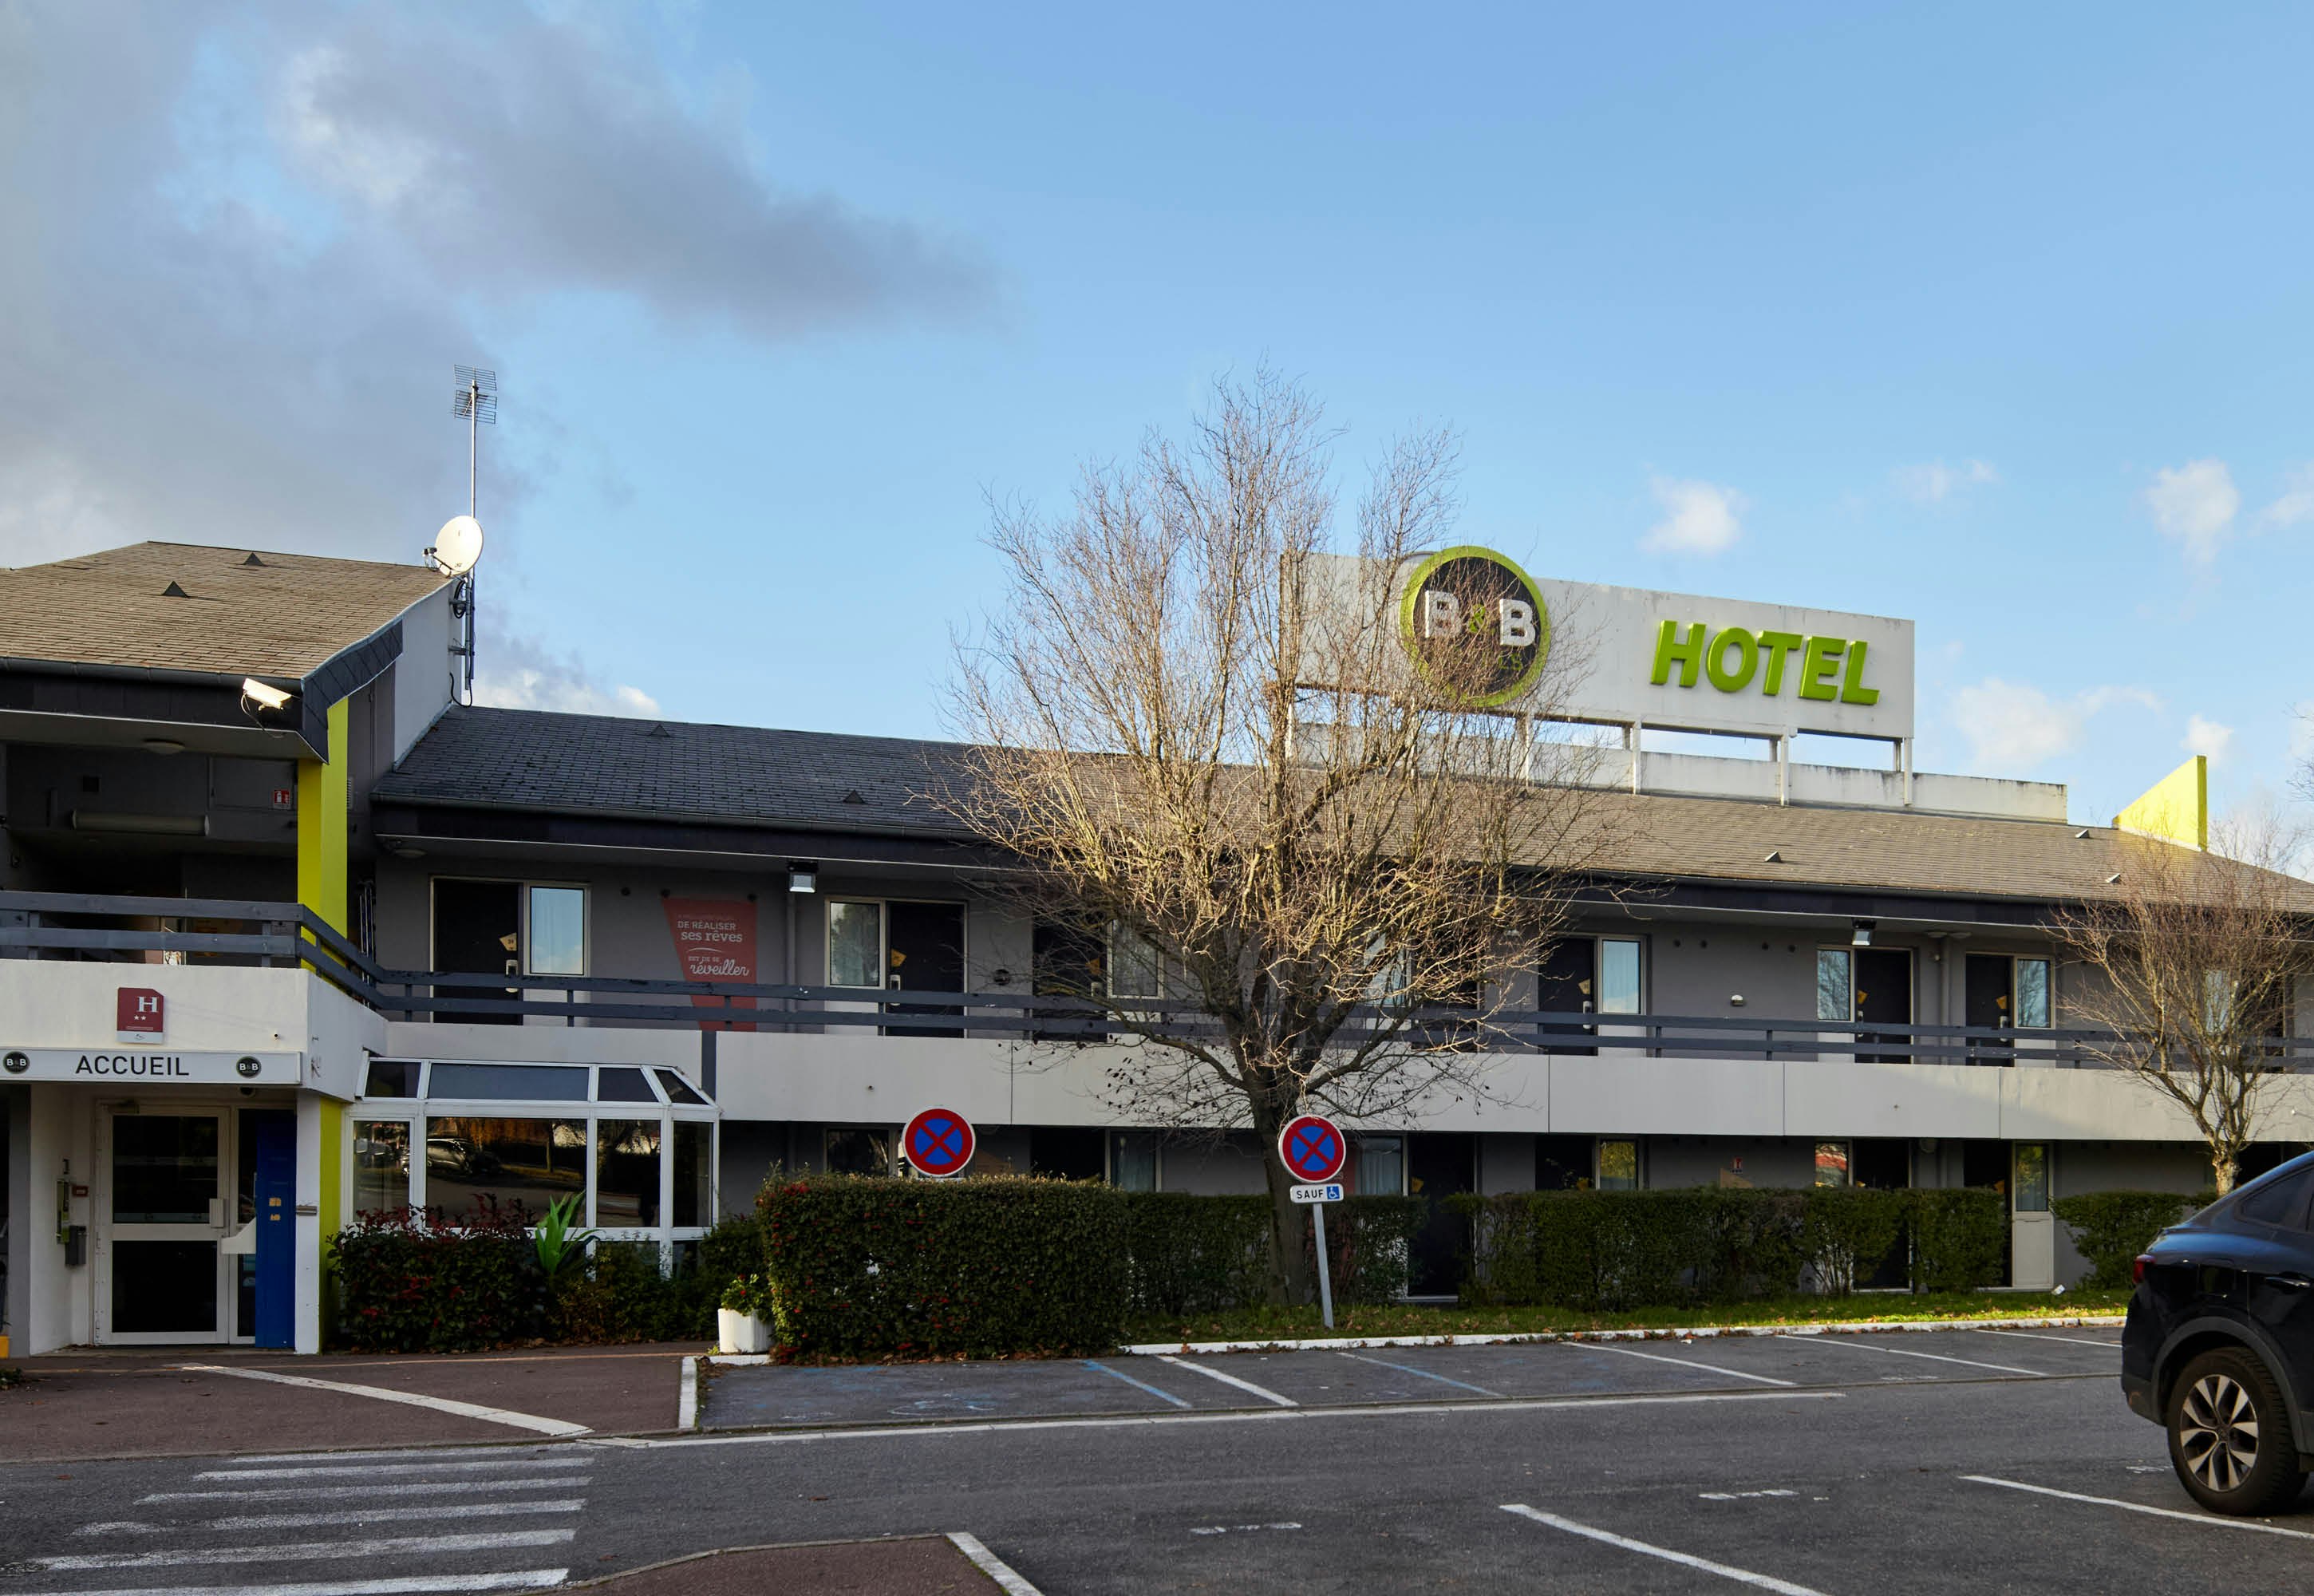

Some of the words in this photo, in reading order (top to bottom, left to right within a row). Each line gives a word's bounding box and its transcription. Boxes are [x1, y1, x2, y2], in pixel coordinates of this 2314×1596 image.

[1650, 619, 1880, 705] HOTEL
[677, 920, 690, 929] DE
[681, 931, 702, 941] ses
[705, 930, 743, 942] rêves
[689, 958, 750, 976] réveiller
[136, 996, 160, 1013] H
[75, 1055, 190, 1076] ACCUEIL
[1296, 1189, 1324, 1199] SAUF
